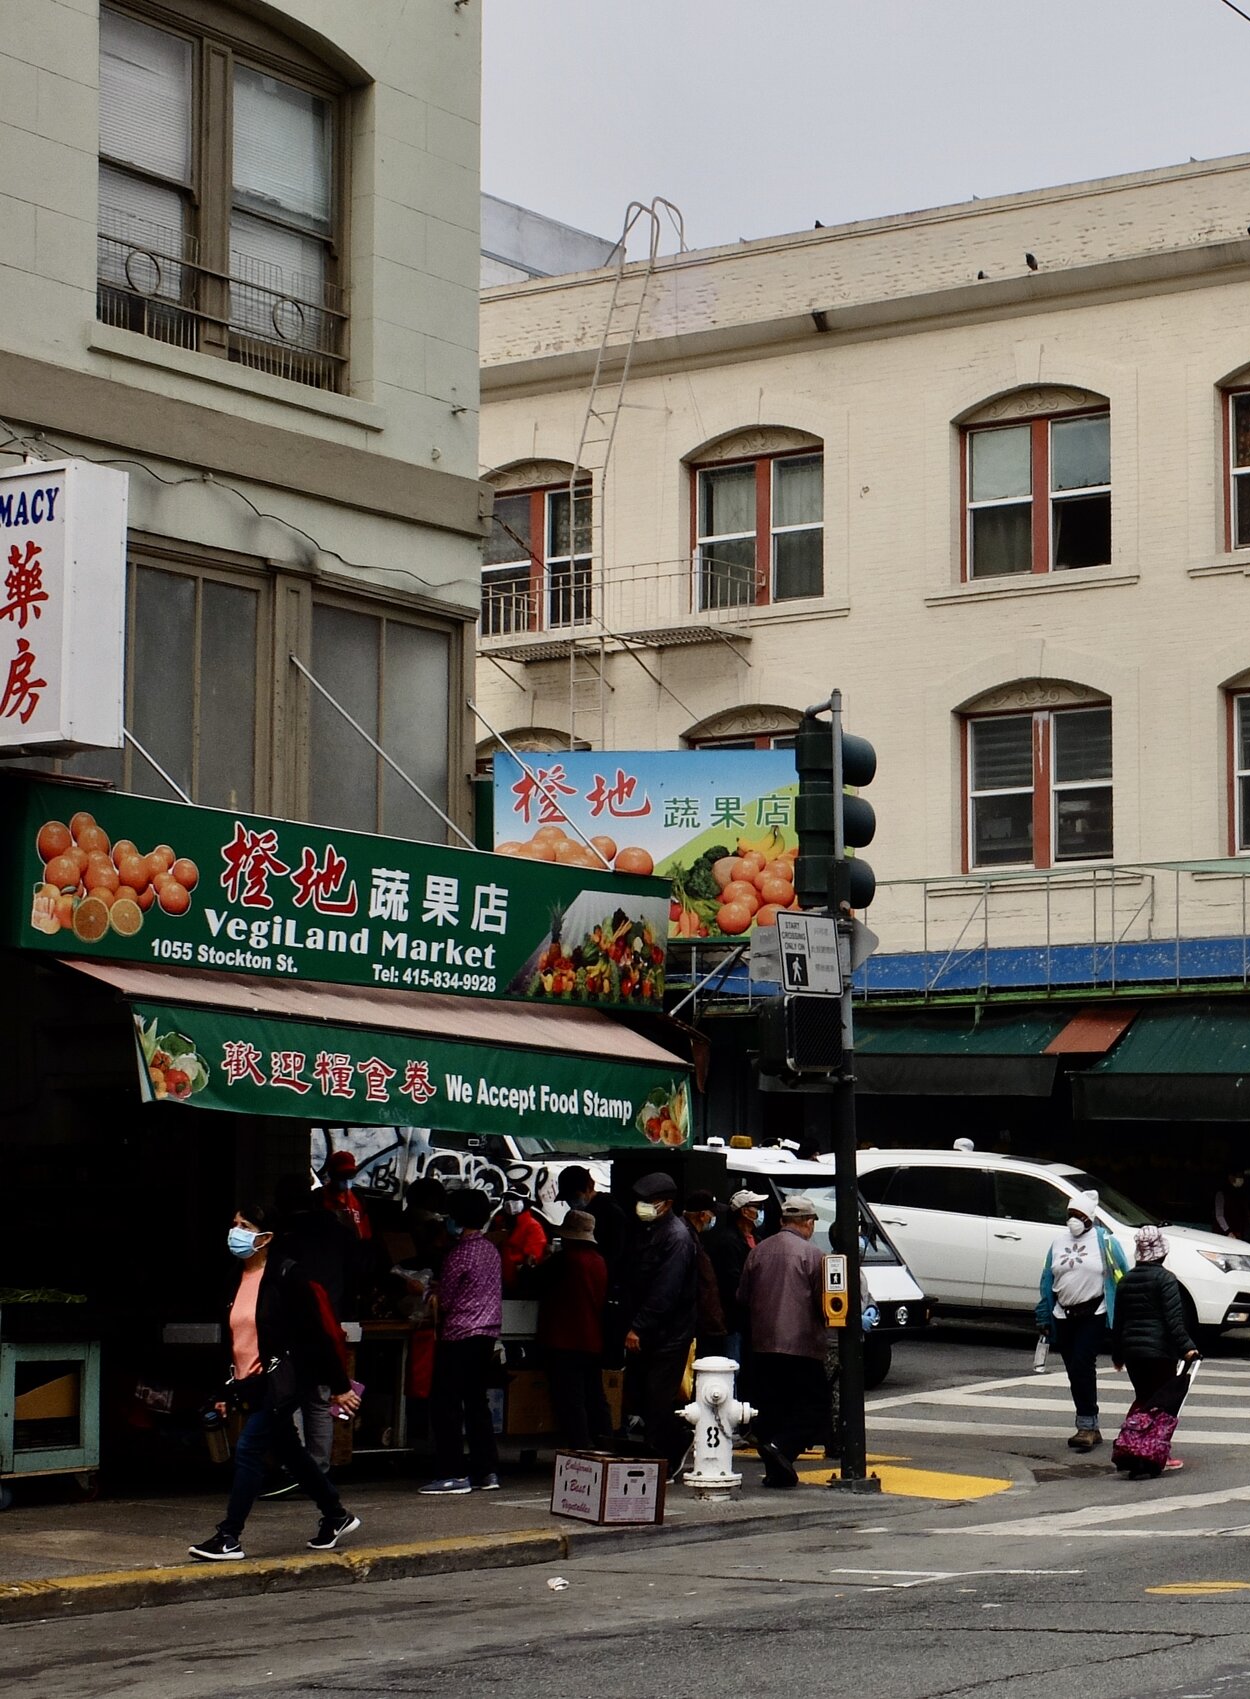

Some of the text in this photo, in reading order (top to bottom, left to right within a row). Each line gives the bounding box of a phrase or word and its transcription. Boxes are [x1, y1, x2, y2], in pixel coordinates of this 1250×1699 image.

[0, 487, 60, 528] MACY
[0, 541, 49, 724] 藥房
[511, 764, 792, 829] 橙地 蔬果店
[221, 821, 510, 936] 橙地 蔬果店
[151, 938, 298, 974] 1055 Stockton St.
[205, 908, 497, 969] VegiLand Market
[372, 964, 497, 992] Tel: 415-834-9928
[446, 1074, 633, 1126] We Accept Food Stamp
[706, 1426, 721, 1448] 8
